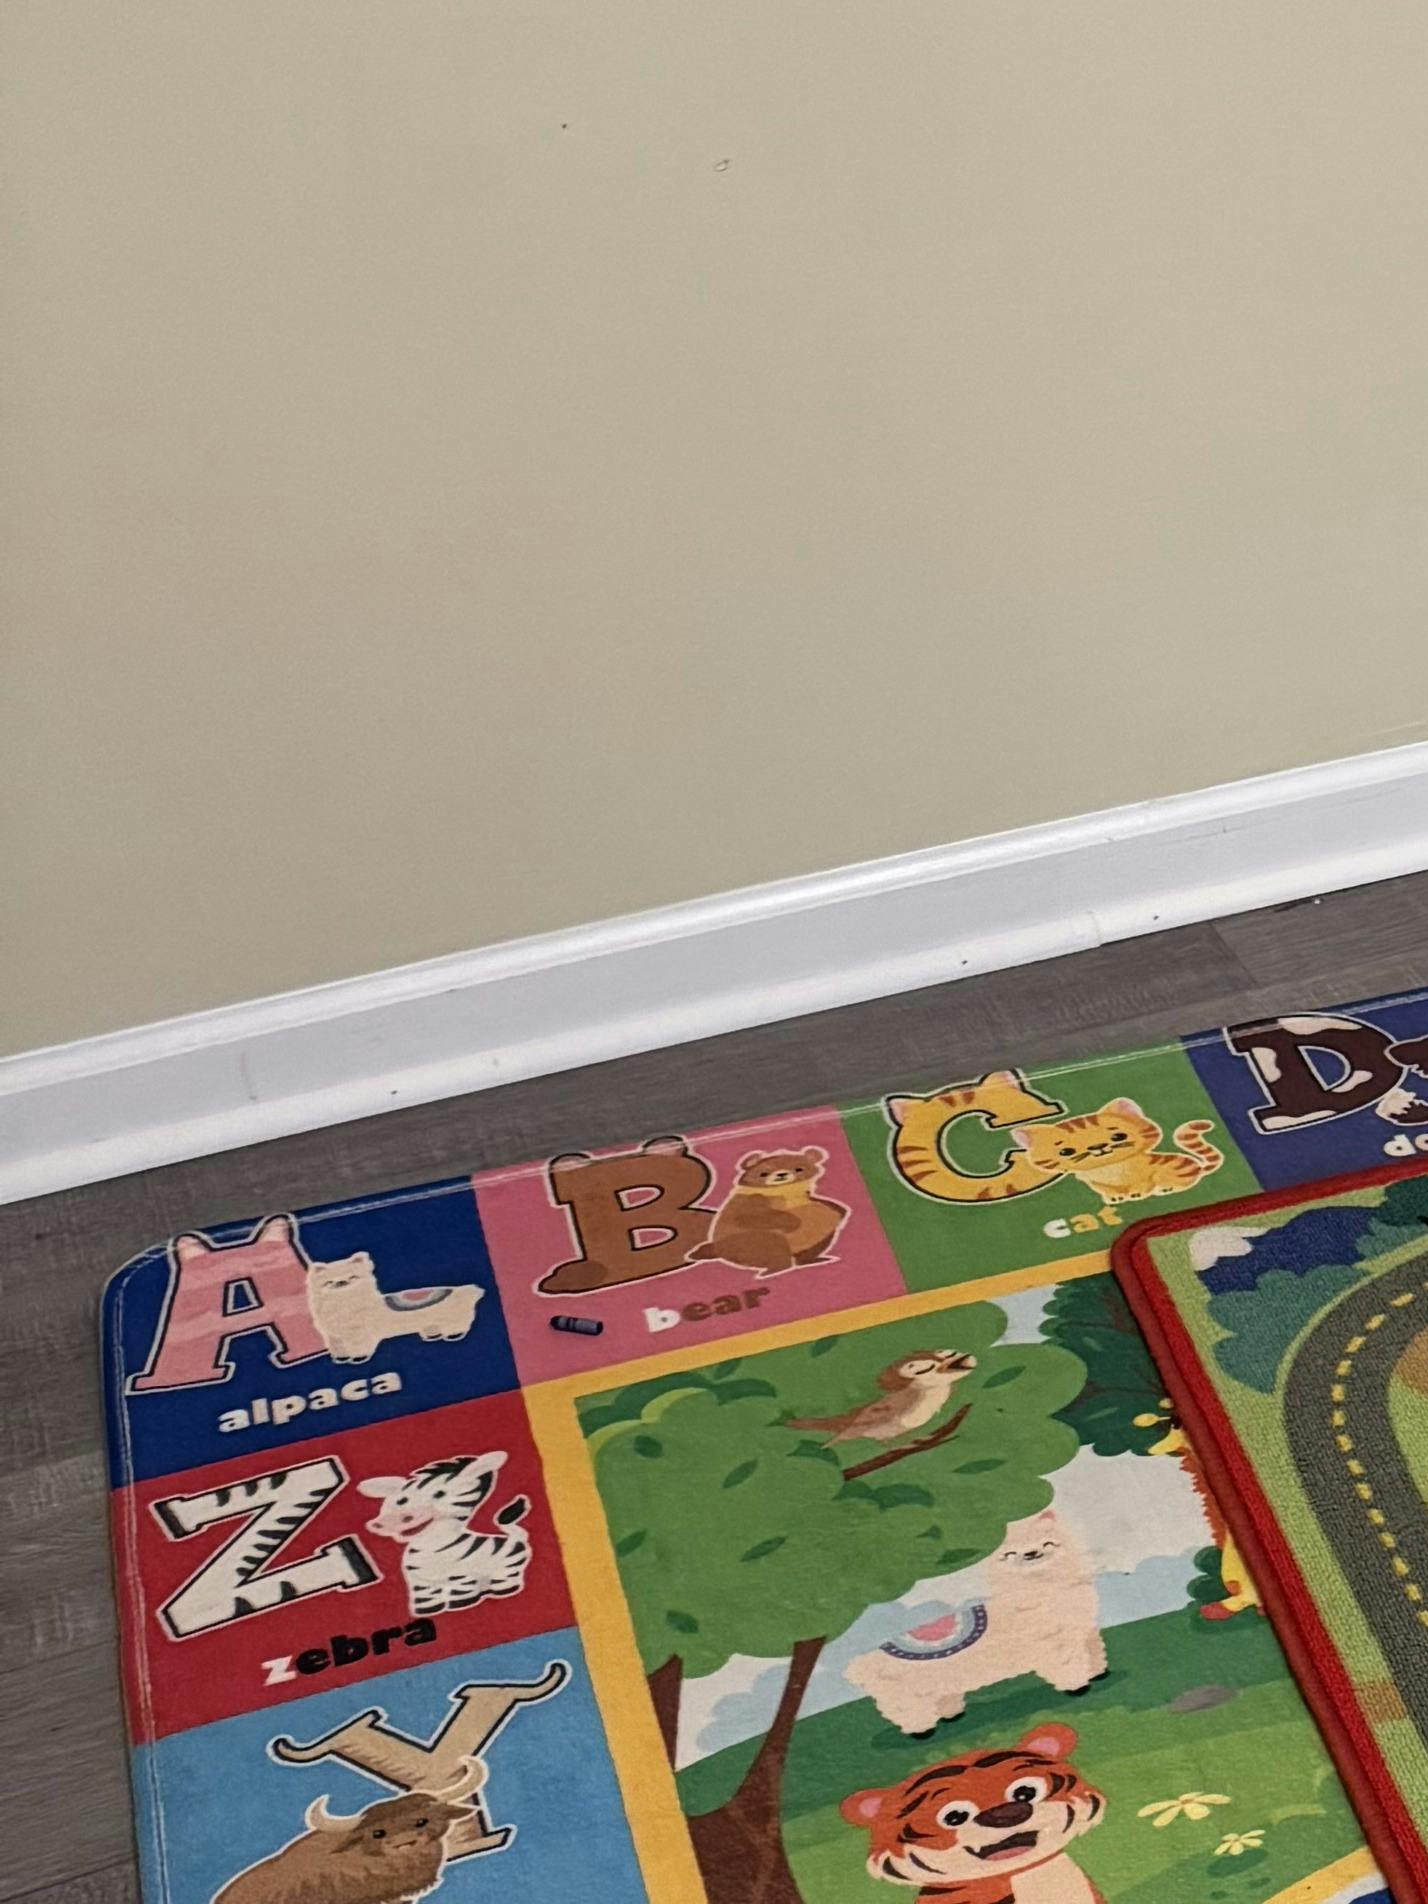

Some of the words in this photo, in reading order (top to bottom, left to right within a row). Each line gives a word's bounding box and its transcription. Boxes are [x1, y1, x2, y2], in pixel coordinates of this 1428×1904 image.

[881, 1068, 1068, 1204] C
[1222, 1012, 1406, 1137] D
[533, 1136, 717, 1296] B
[1042, 1205, 1123, 1240] cat
[125, 1212, 332, 1395] A
[644, 1284, 770, 1334] bear
[217, 1370, 402, 1435] alpaca
[149, 1455, 382, 1642] Z
[260, 1616, 436, 1687] zebra
[268, 1659, 570, 1865] Y
